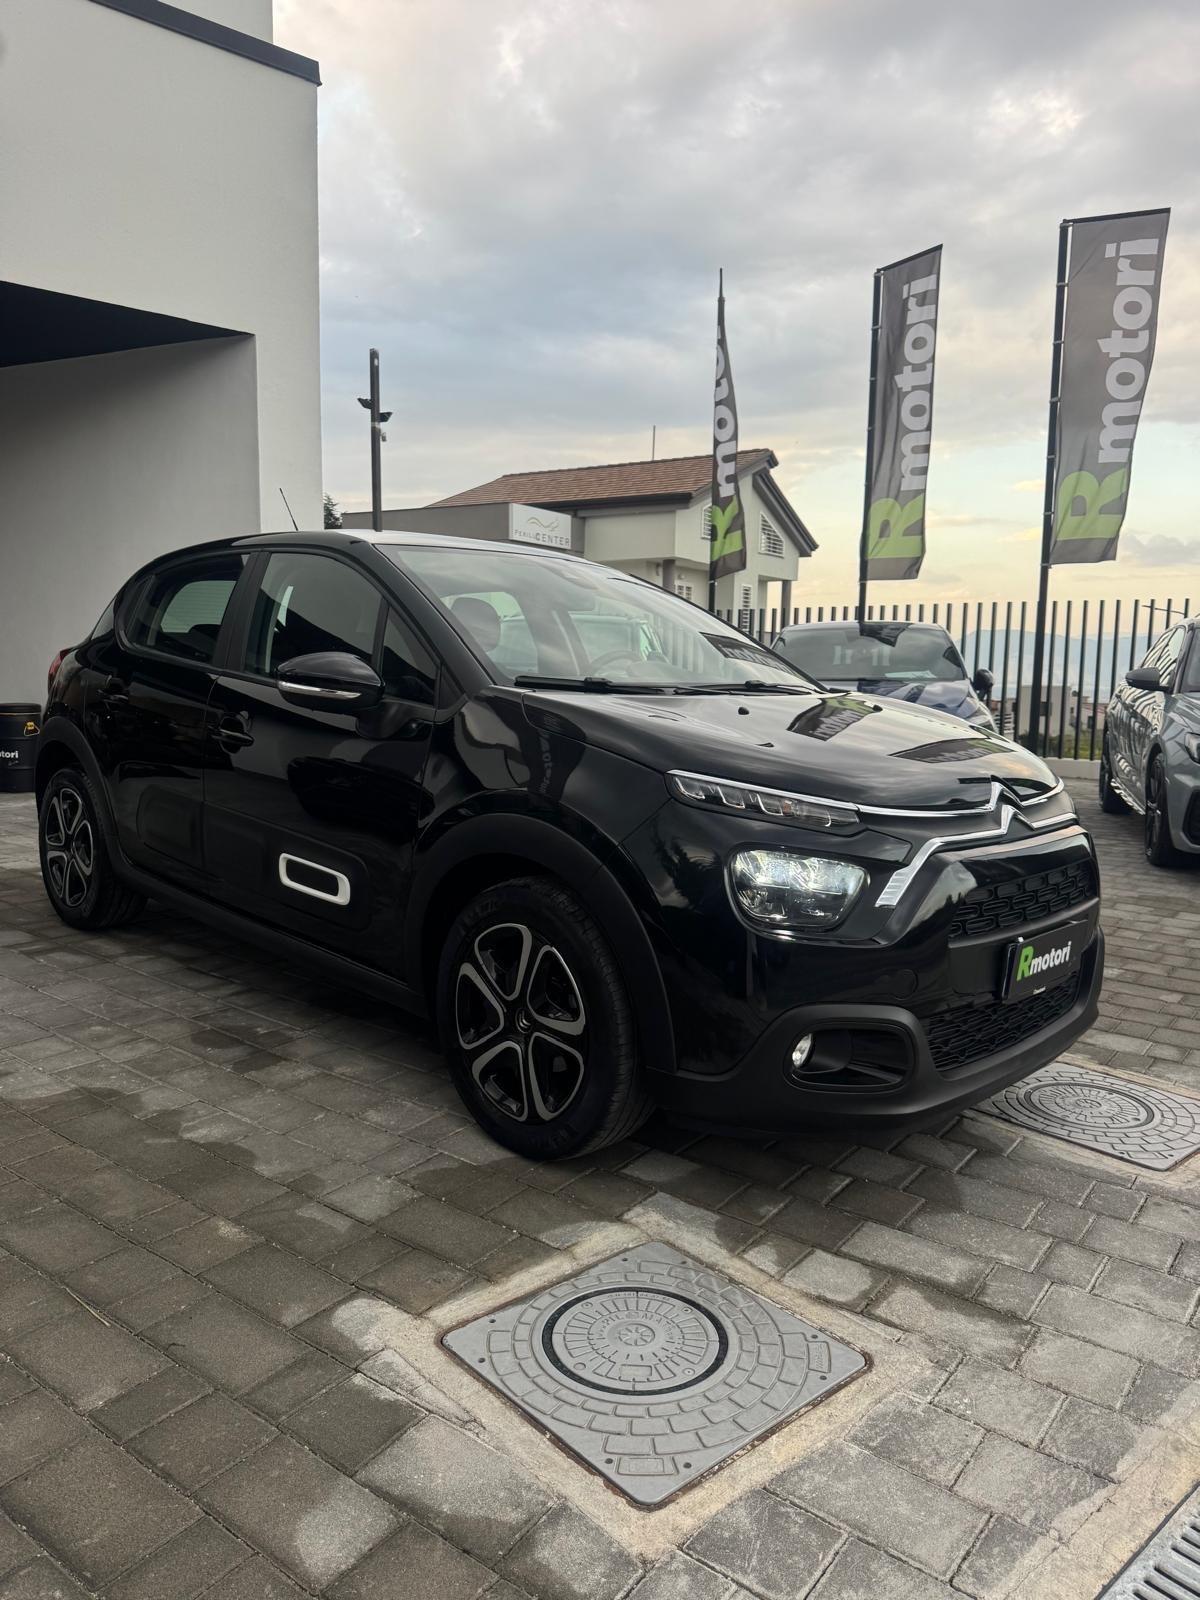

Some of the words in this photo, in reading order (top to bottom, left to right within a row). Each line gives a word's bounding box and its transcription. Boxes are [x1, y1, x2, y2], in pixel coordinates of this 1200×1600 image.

[867, 273, 938, 560] Rmotori
[1056, 237, 1160, 541] Rmotori
[535, 532, 570, 546] CENTER
[1016, 941, 1072, 981] Rmotori
